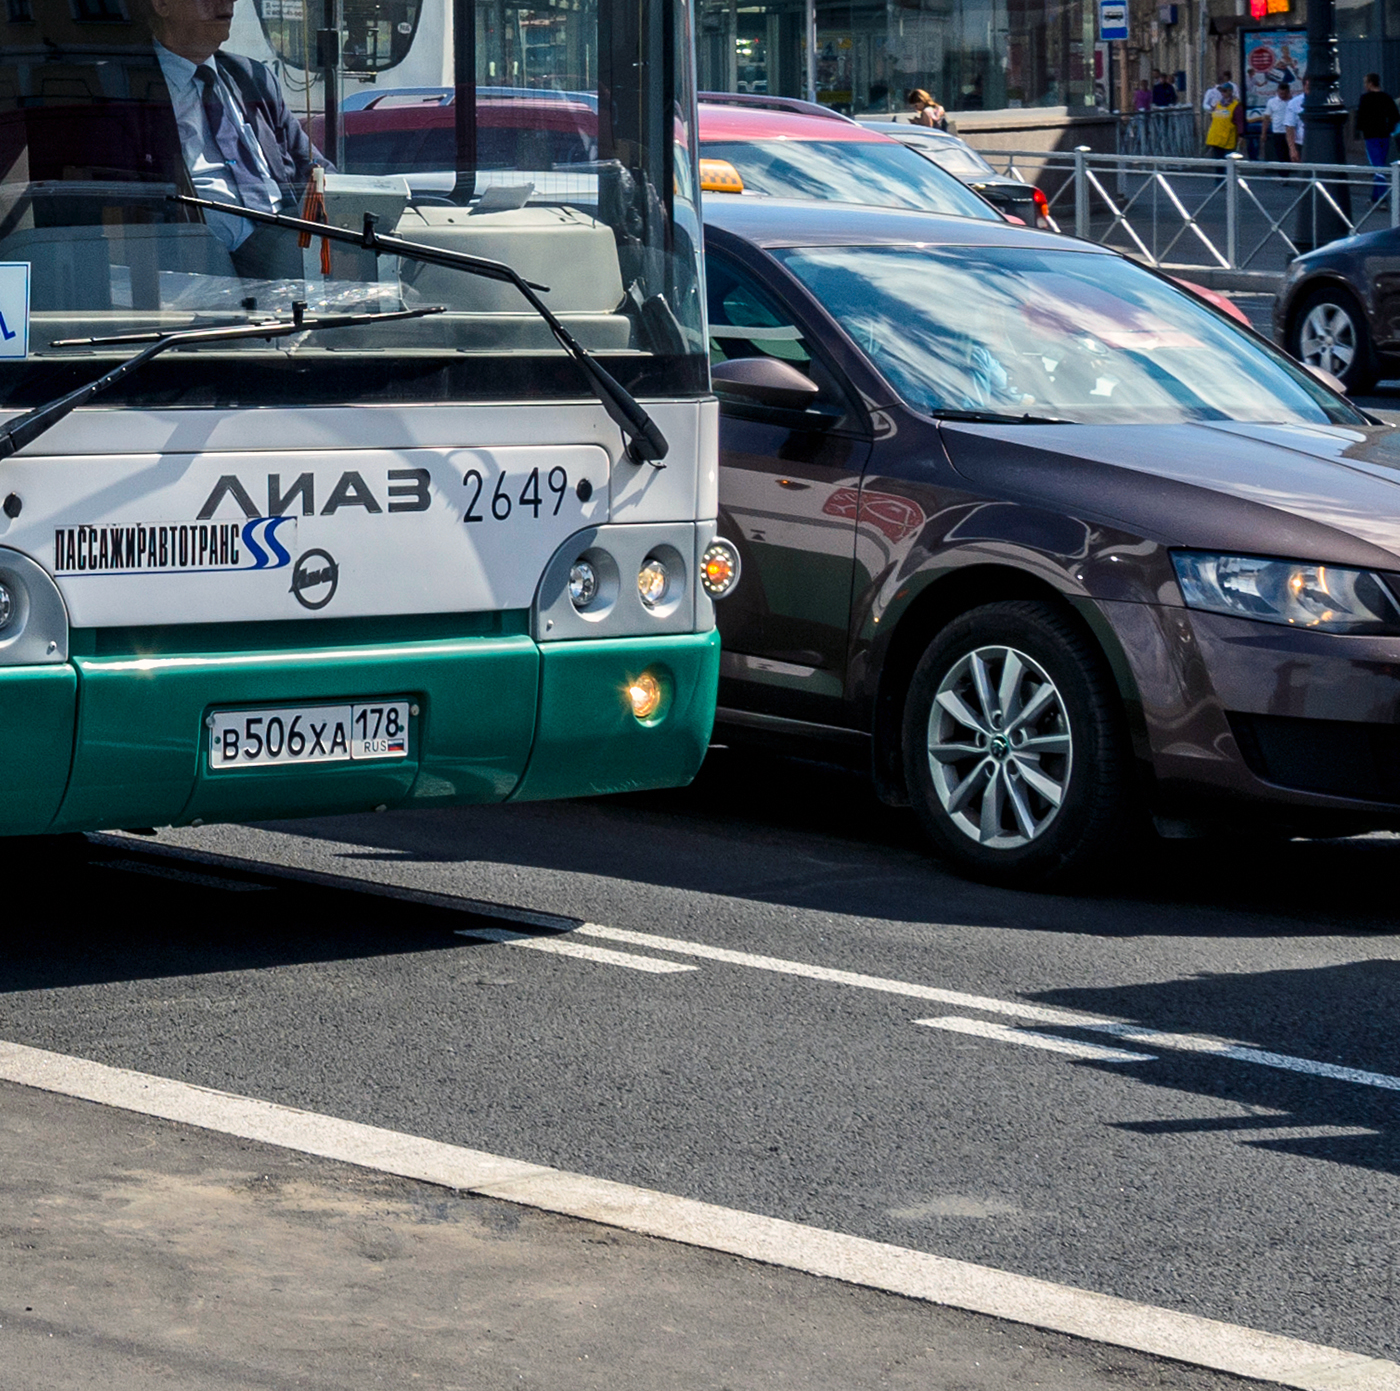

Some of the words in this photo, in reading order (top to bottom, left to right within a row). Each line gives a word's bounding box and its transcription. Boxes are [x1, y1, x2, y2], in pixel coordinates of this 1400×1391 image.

[196, 467, 432, 521] ЛИАЗ
[462, 465, 569, 523] 2649
[54, 523, 240, 571] ПАССАЖИРАВТОТРАНС
[222, 715, 348, 761] В506ХА
[355, 707, 400, 740] 178
[363, 740, 387, 753] RUS
